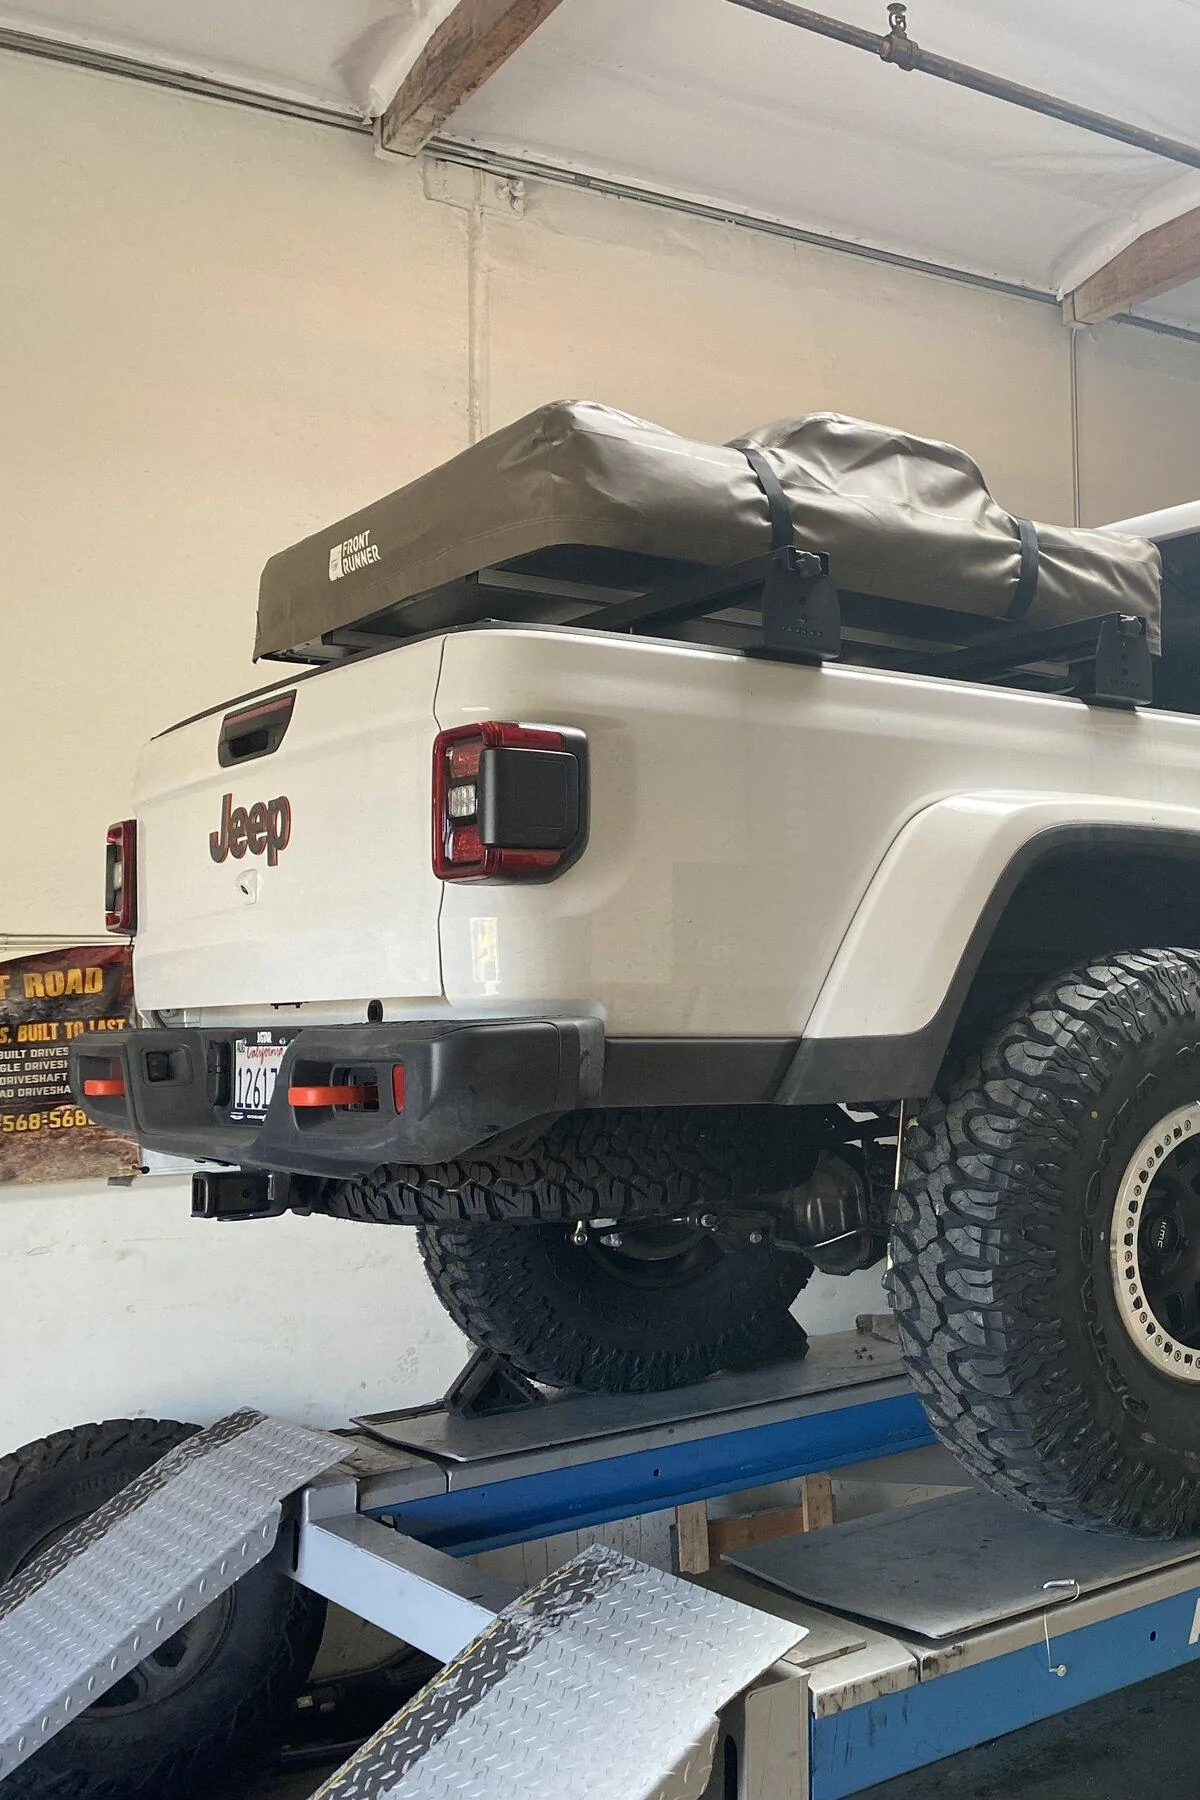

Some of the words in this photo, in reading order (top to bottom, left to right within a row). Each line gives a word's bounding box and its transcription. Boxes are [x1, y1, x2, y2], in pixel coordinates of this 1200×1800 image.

[342, 530, 370, 557] FRONT
[342, 545, 381, 574] RUNNER
[209, 793, 291, 867] Jeep
[23, 967, 103, 998] ROAD
[17, 1022, 59, 1043] BUILT
